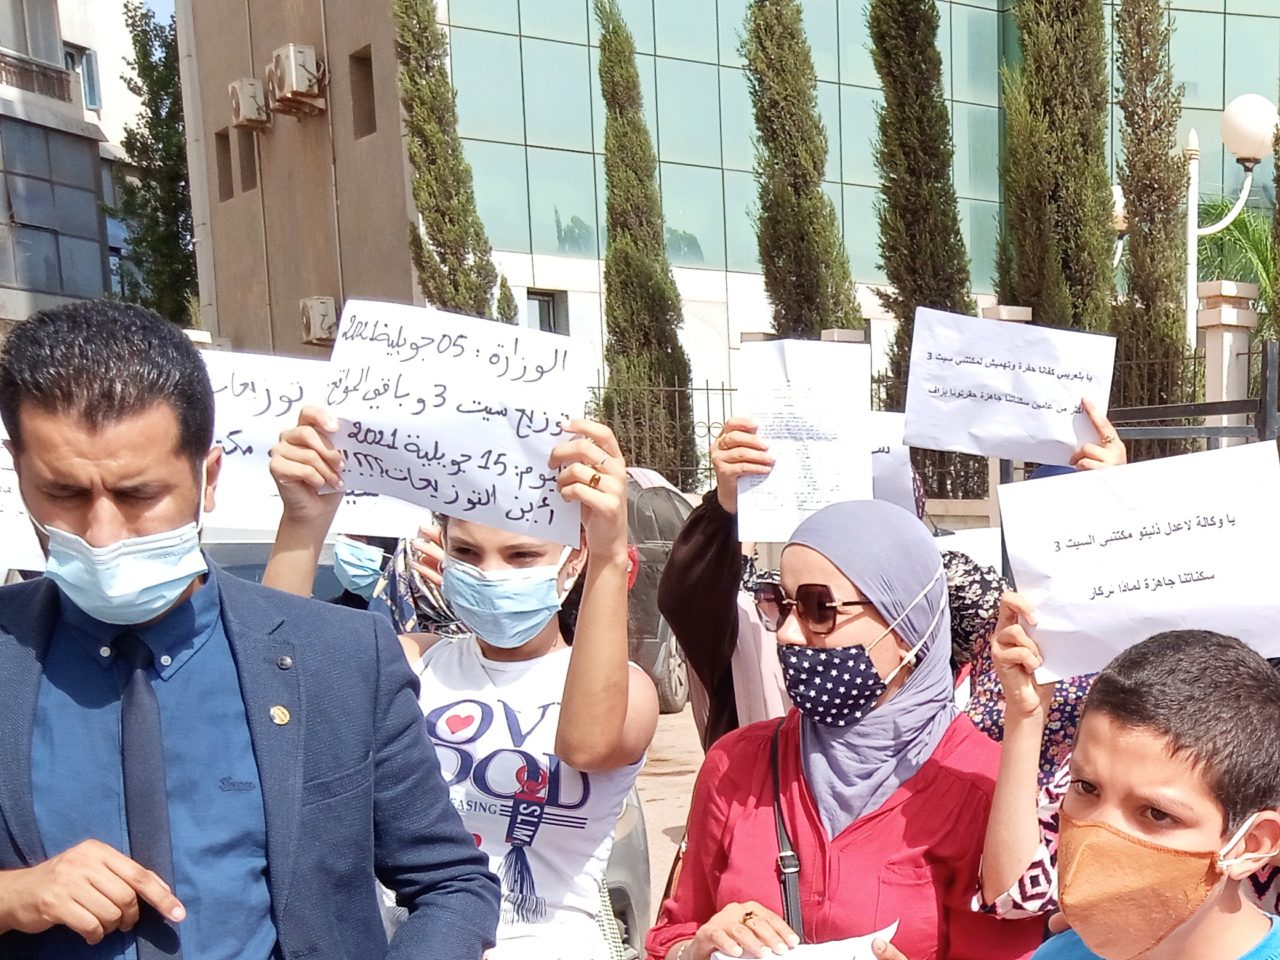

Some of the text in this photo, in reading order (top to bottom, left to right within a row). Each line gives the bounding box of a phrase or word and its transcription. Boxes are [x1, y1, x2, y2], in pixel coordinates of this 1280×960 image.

[489, 338, 567, 382] الوزارة
[347, 421, 399, 450] 2021
[477, 450, 507, 476] 15
[1196, 514, 1224, 528] وكالة
[1226, 513, 1236, 526] يا
[1053, 541, 1061, 552] 3
[1065, 534, 1095, 550] السيت
[1118, 578, 1141, 593] لماذا
[1144, 576, 1176, 592] جاهزة
[512, 803, 541, 844] SLIM
